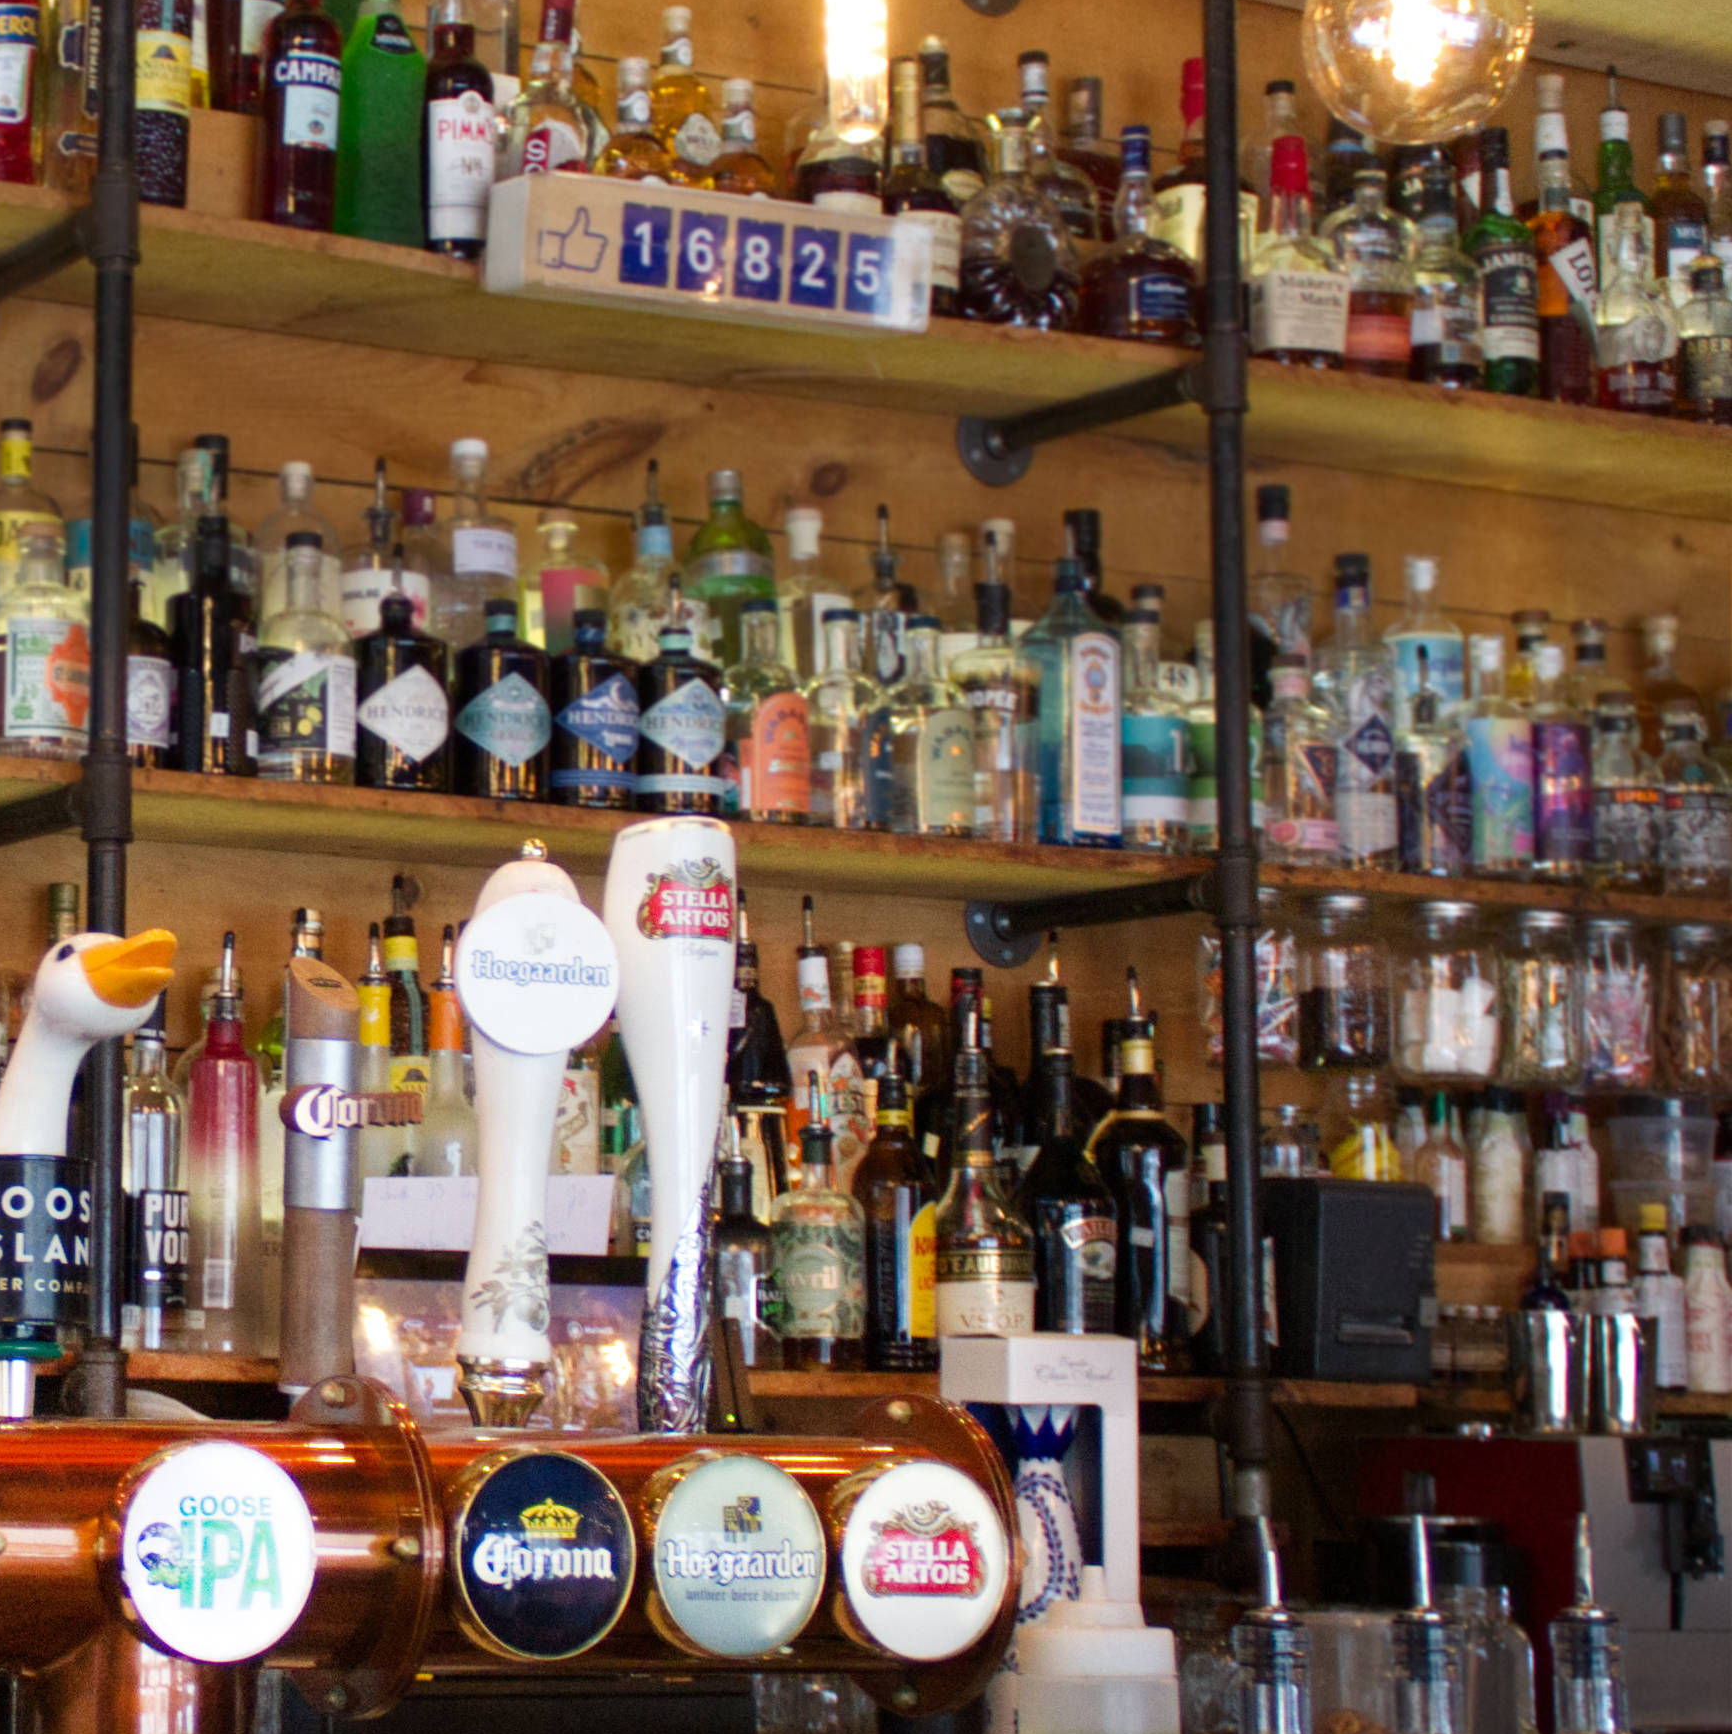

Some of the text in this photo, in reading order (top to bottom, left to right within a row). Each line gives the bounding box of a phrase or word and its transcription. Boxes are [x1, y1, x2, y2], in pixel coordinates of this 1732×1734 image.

[630, 220, 882, 296] 16825
[1277, 274, 1345, 294] Maker's
[1299, 290, 1343, 309] Mark
[659, 888, 729, 910] STELLA
[658, 907, 732, 929] ARTOIS
[471, 949, 611, 988] Hoegaarden
[179, 1495, 272, 1518] GOOSE
[472, 1531, 616, 1590] Corona
[664, 1538, 818, 1587] Hoegaarden
[884, 1540, 970, 1563] STELLA
[178, 1518, 284, 1611] IPA
[882, 1563, 971, 1586] ARTOIS
